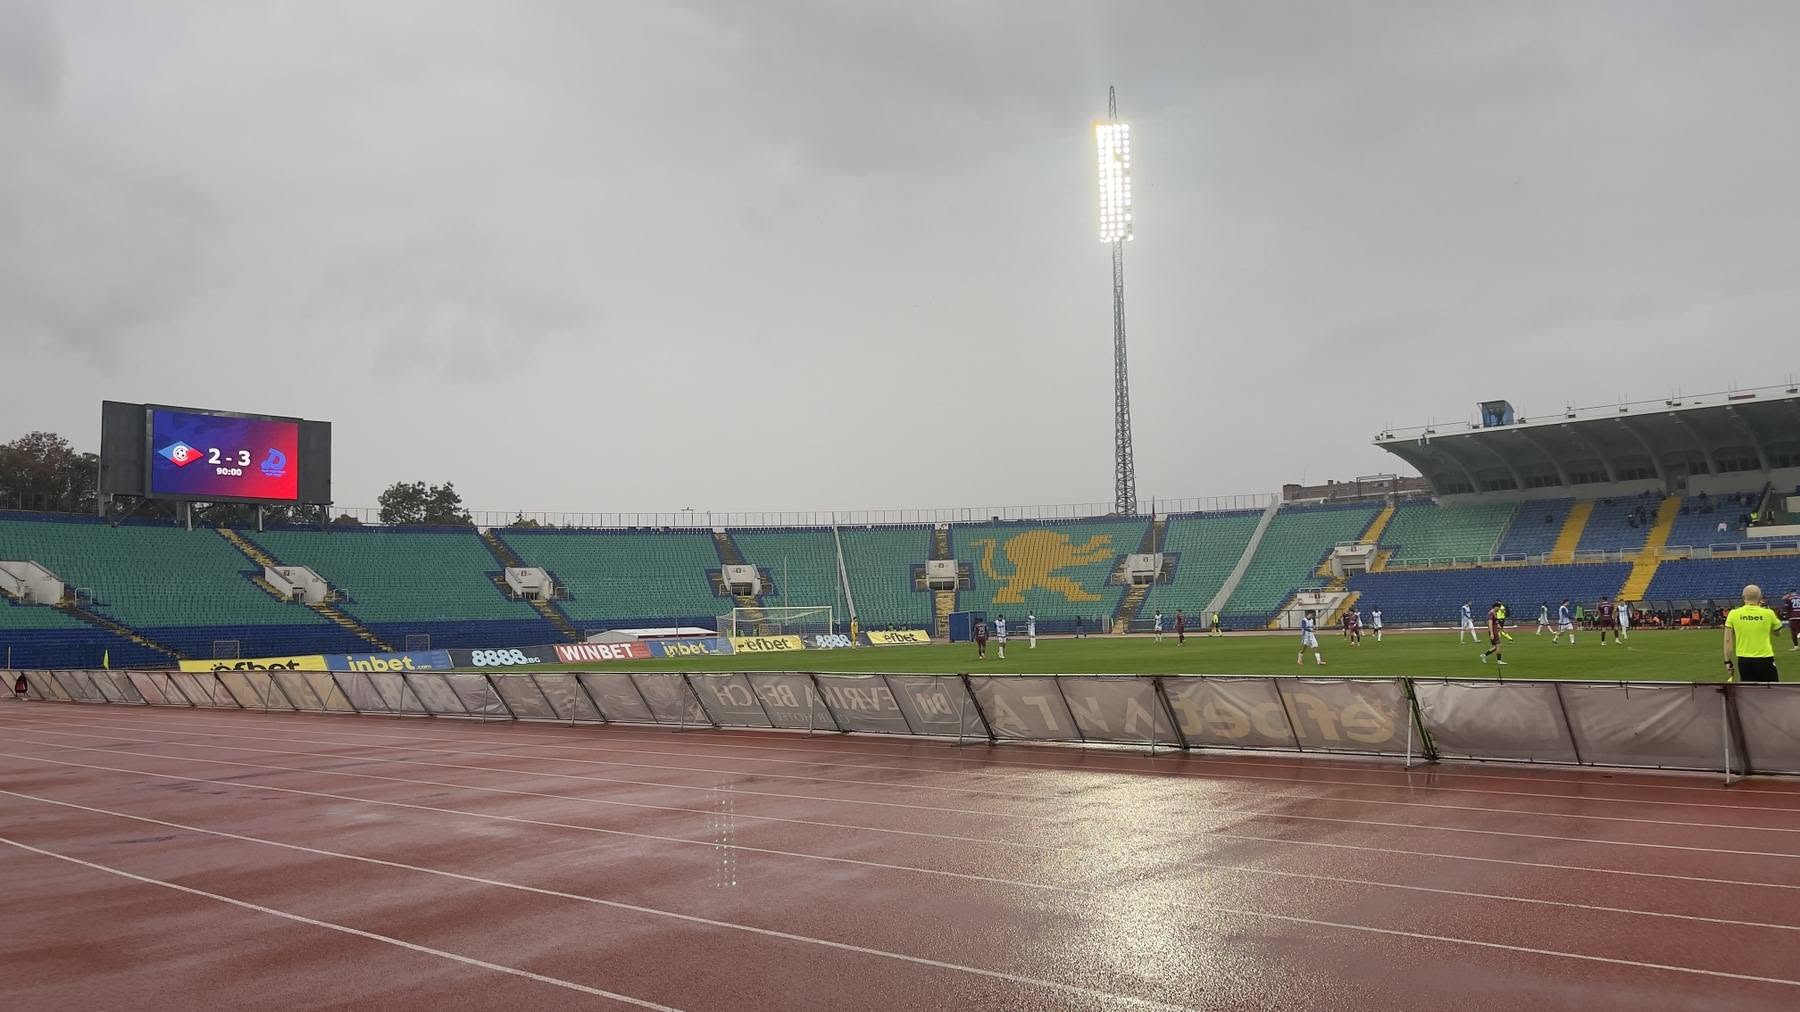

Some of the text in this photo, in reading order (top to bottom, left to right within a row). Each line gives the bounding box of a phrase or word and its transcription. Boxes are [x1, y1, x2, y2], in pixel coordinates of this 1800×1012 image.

[208, 448, 221, 464] 2
[238, 450, 250, 466] 3
[216, 467, 242, 476] 90:00
[884, 631, 917, 642] efbet
[661, 641, 709, 657] inbet
[748, 638, 789, 651] efbet
[560, 643, 634, 661] WINBET
